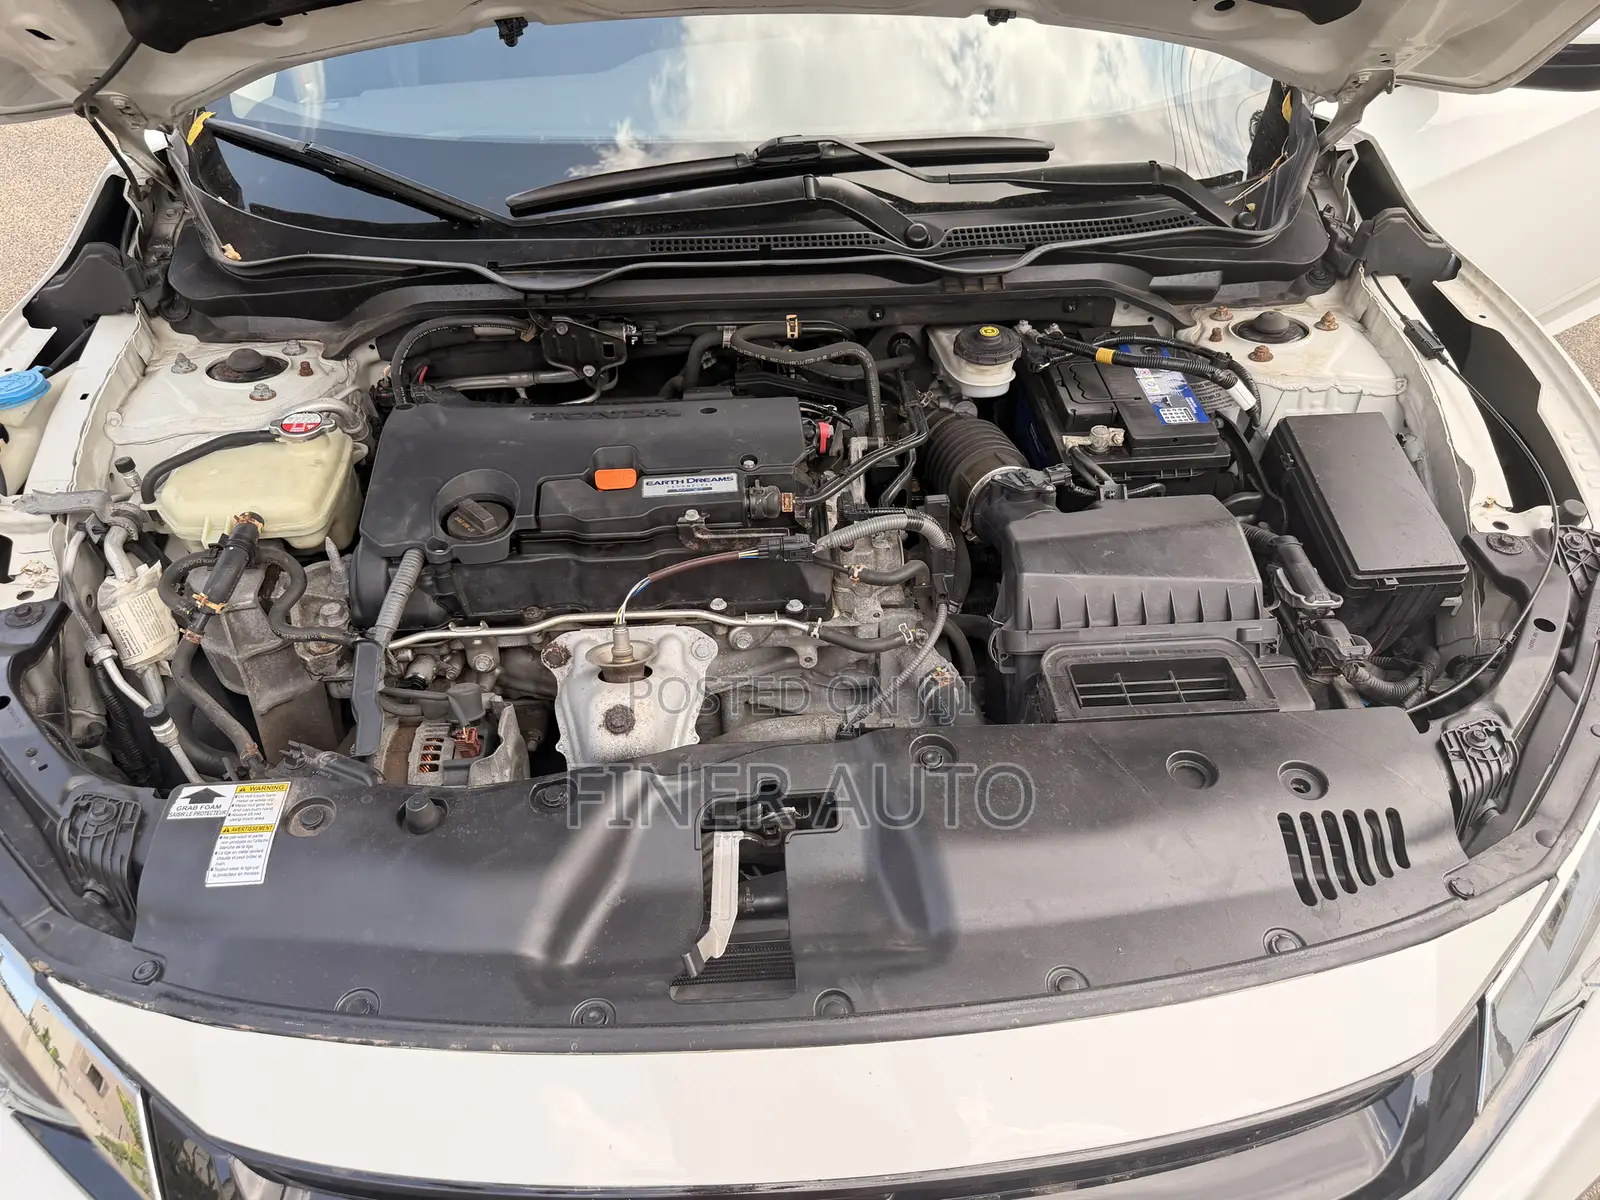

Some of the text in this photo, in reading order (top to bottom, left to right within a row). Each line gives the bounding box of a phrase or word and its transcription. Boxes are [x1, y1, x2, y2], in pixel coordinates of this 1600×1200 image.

[530, 407, 681, 421] HONDA
[645, 475, 734, 487] EARTH DREAMS
